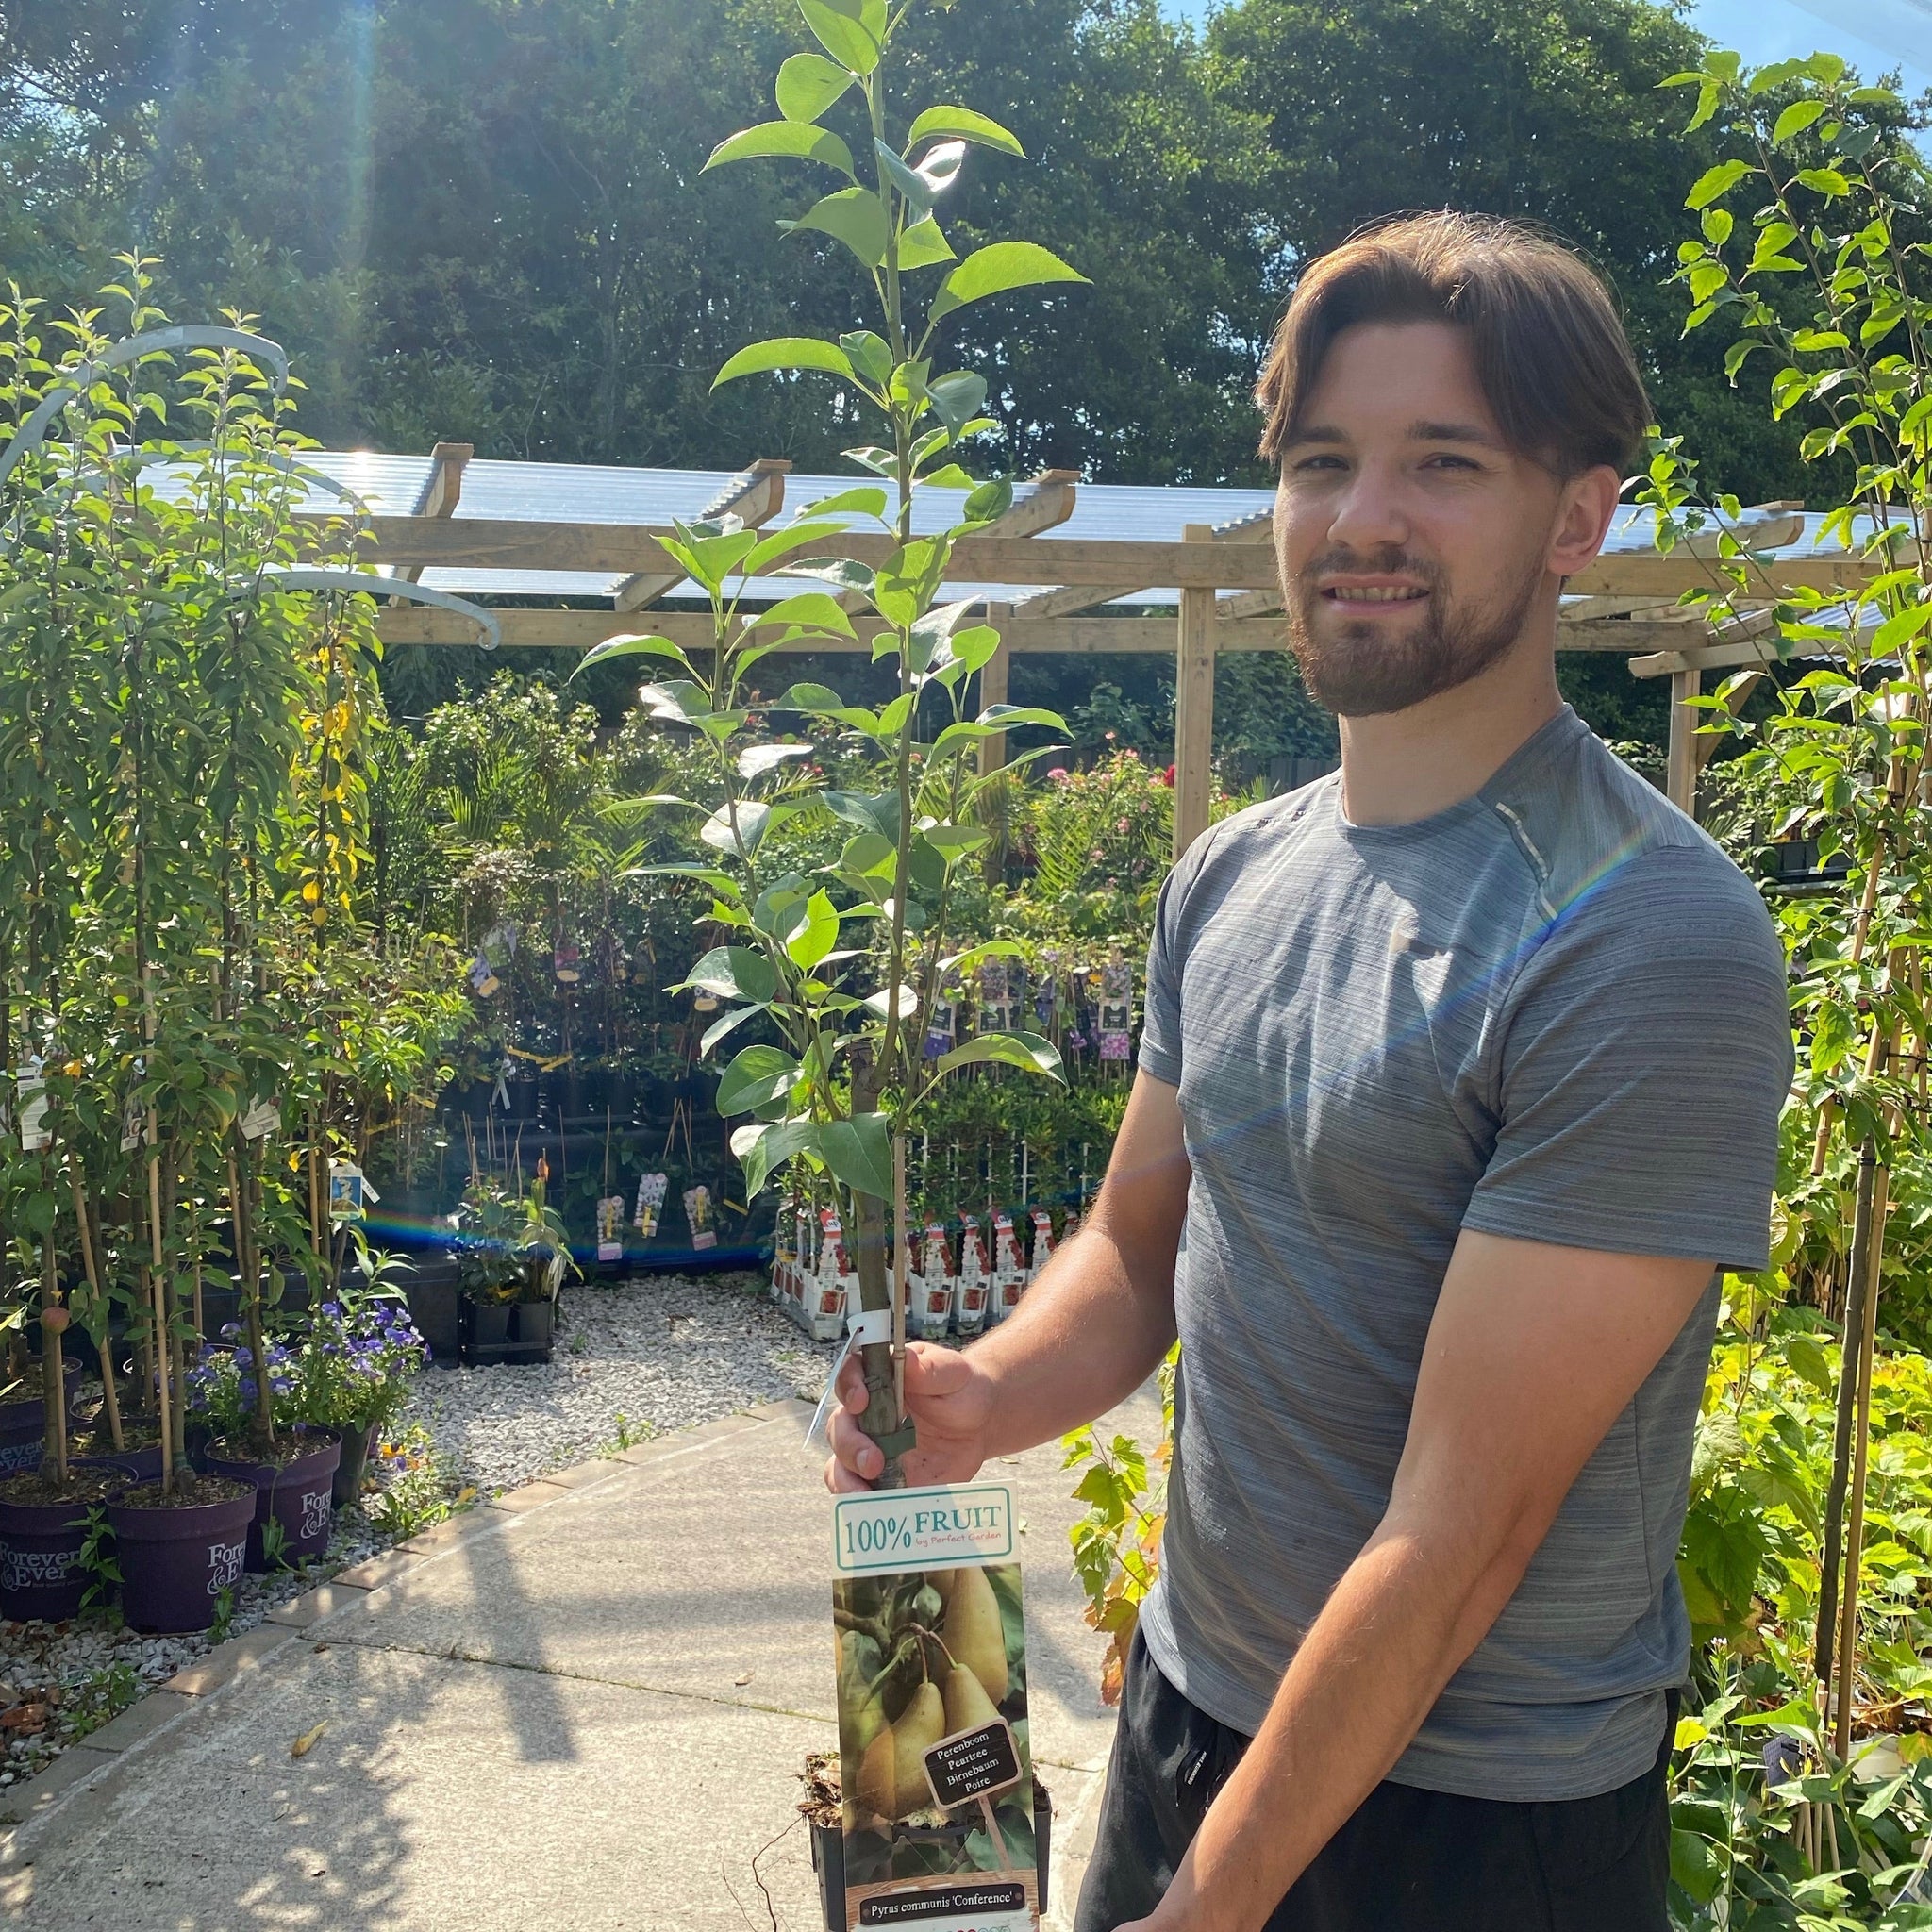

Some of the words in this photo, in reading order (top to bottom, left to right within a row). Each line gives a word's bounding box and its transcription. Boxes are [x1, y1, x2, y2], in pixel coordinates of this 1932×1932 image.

[0, 1455, 39, 1472] ver
[845, 1516, 912, 1554] 100%
[914, 1506, 1002, 1534] FRUIT
[915, 1537, 929, 1548] by
[930, 1534, 965, 1545] Perfect
[967, 1531, 1002, 1542] Garden
[937, 1733, 990, 1760] Perenboom
[946, 1758, 1000, 1786] Birnebaum
[947, 1748, 988, 1771] Peartree
[965, 1777, 991, 1792] Poire
[871, 1904, 899, 1919] Pyrus
[901, 1896, 950, 1912] communis
[952, 1891, 1013, 1907] 'Conference'
